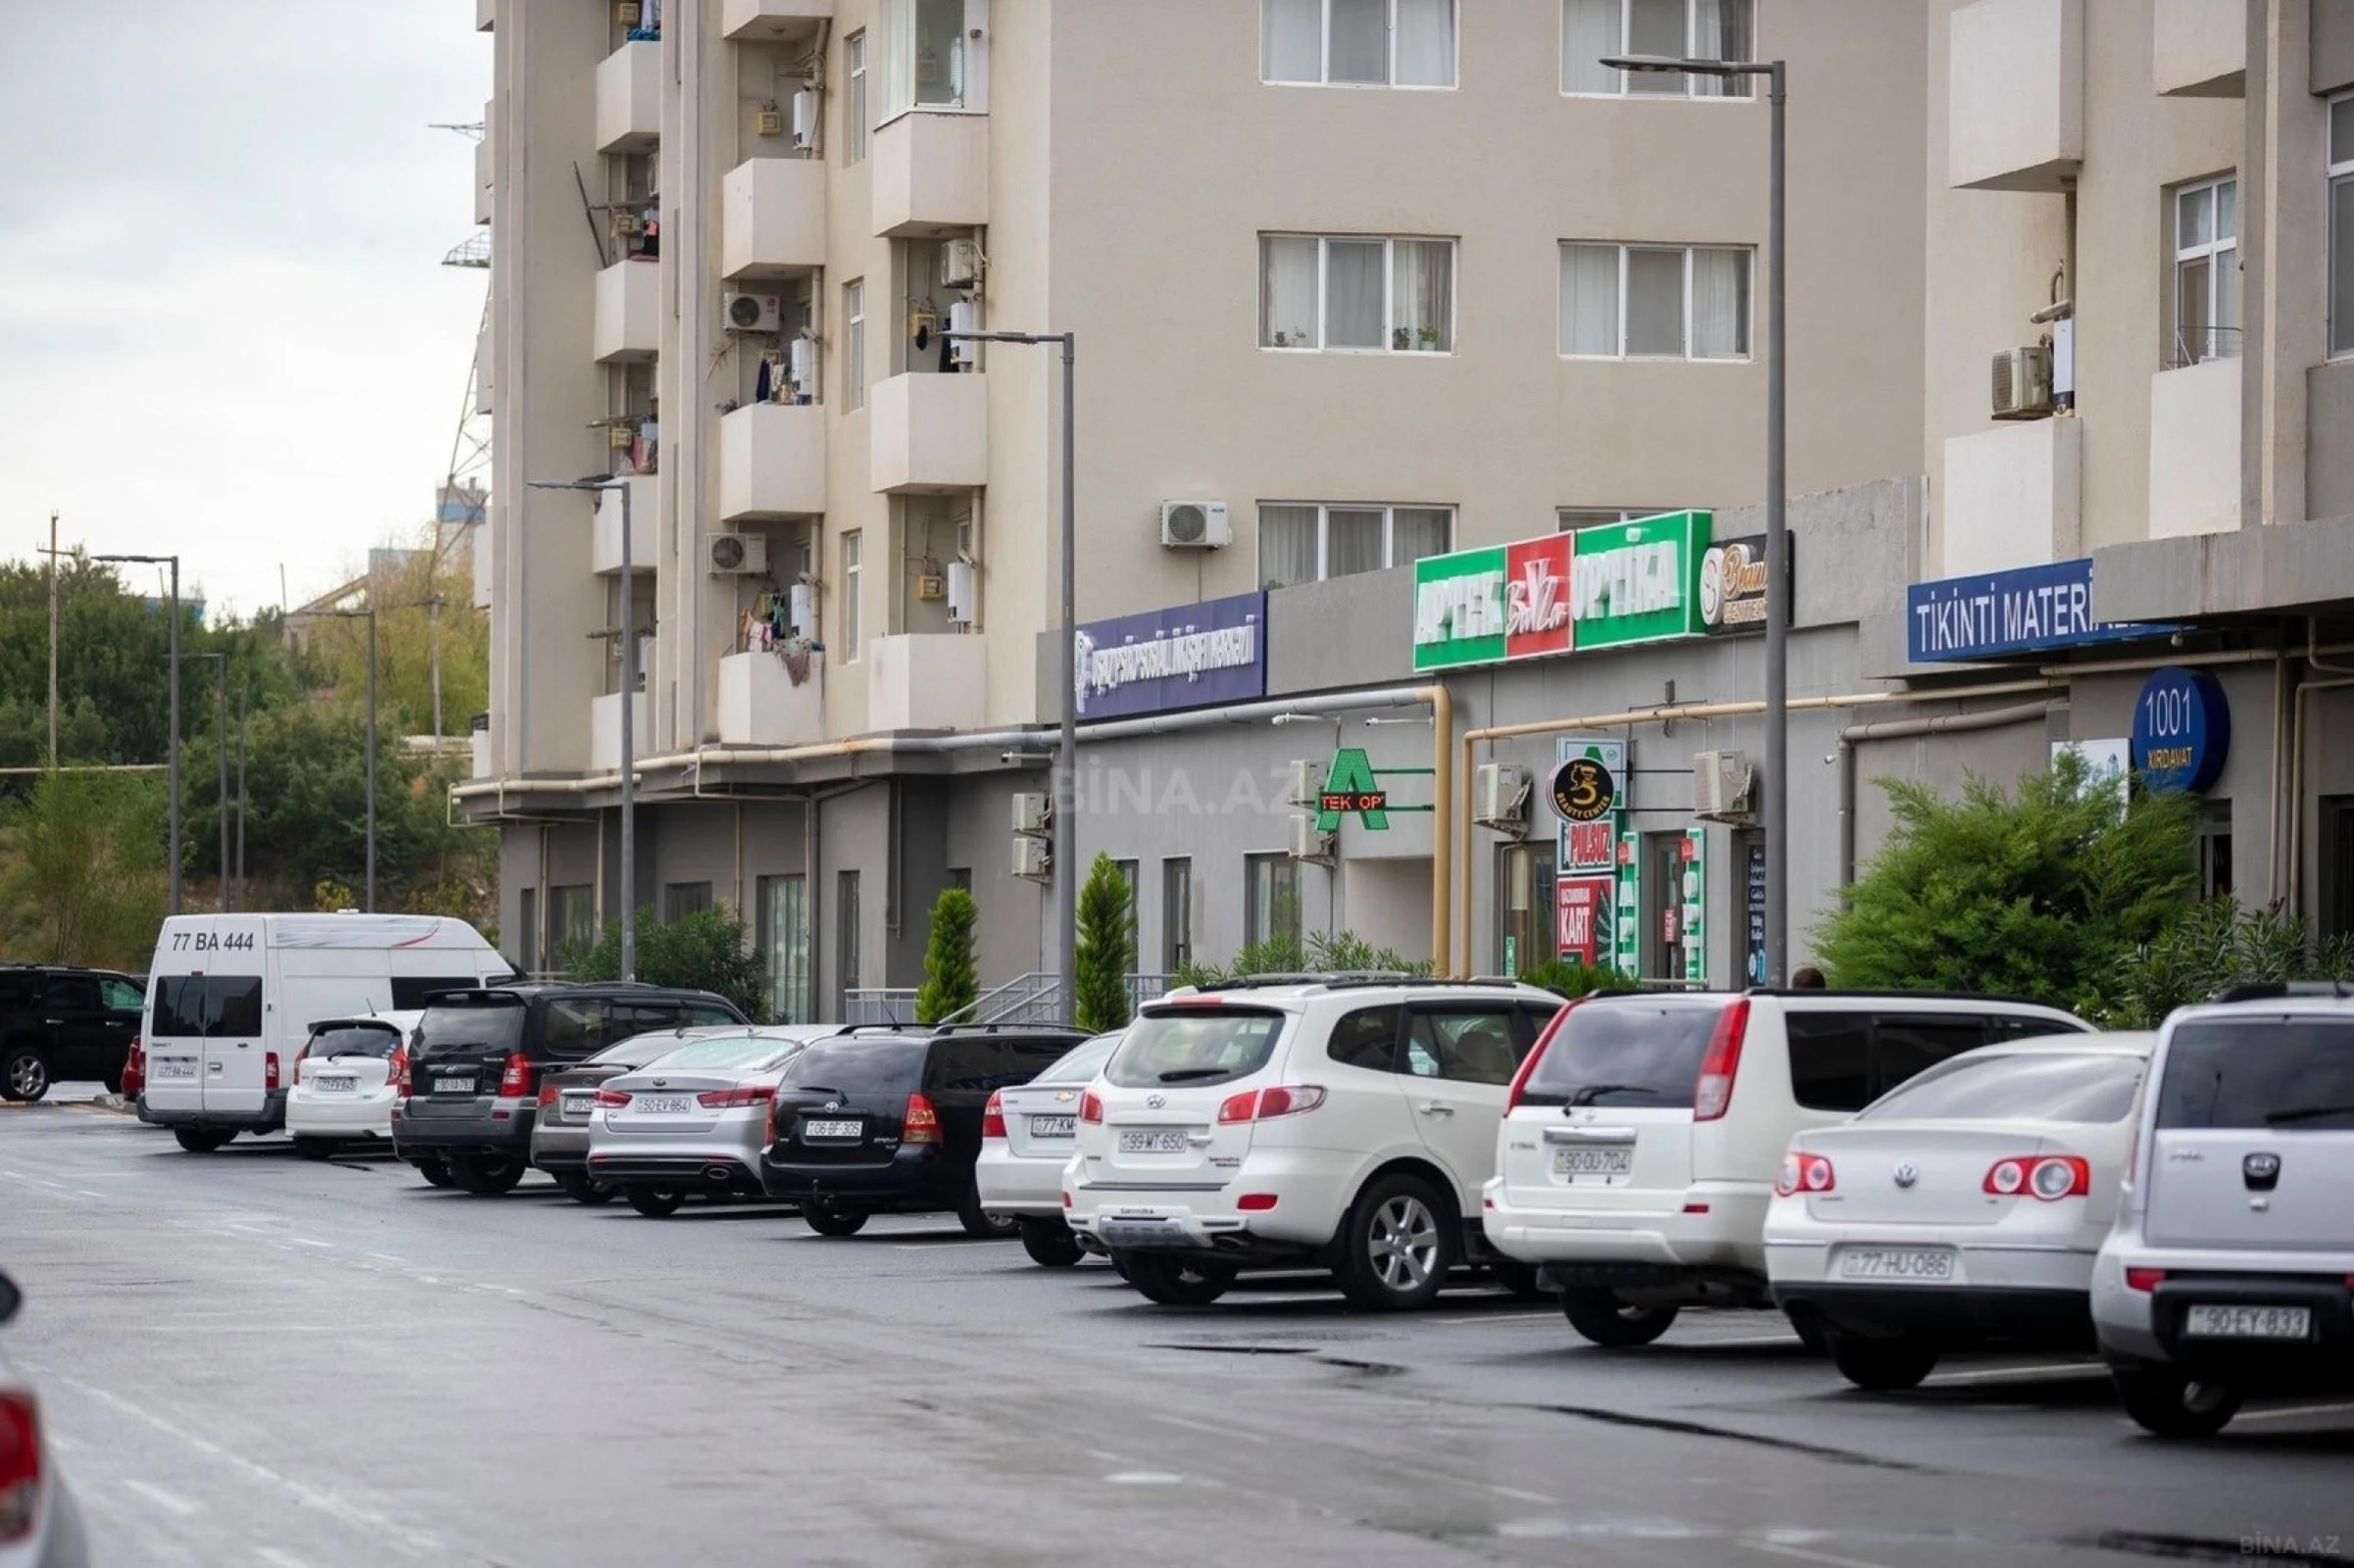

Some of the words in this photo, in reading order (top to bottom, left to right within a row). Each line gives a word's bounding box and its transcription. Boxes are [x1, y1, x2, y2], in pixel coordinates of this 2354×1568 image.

[1916, 581, 1996, 653] TİKİNTİ
[2003, 567, 2136, 643] MATERİ
[2145, 687, 2191, 737] 1001
[1320, 795, 1351, 810] TEK
[1358, 795, 1385, 810] OP
[1555, 791, 1583, 819] BEAUTY
[1582, 795, 1611, 820] CENTER
[172, 933, 191, 952] 77
[195, 932, 219, 952] BA
[223, 932, 254, 952] 444
[1560, 906, 1591, 946] KART
